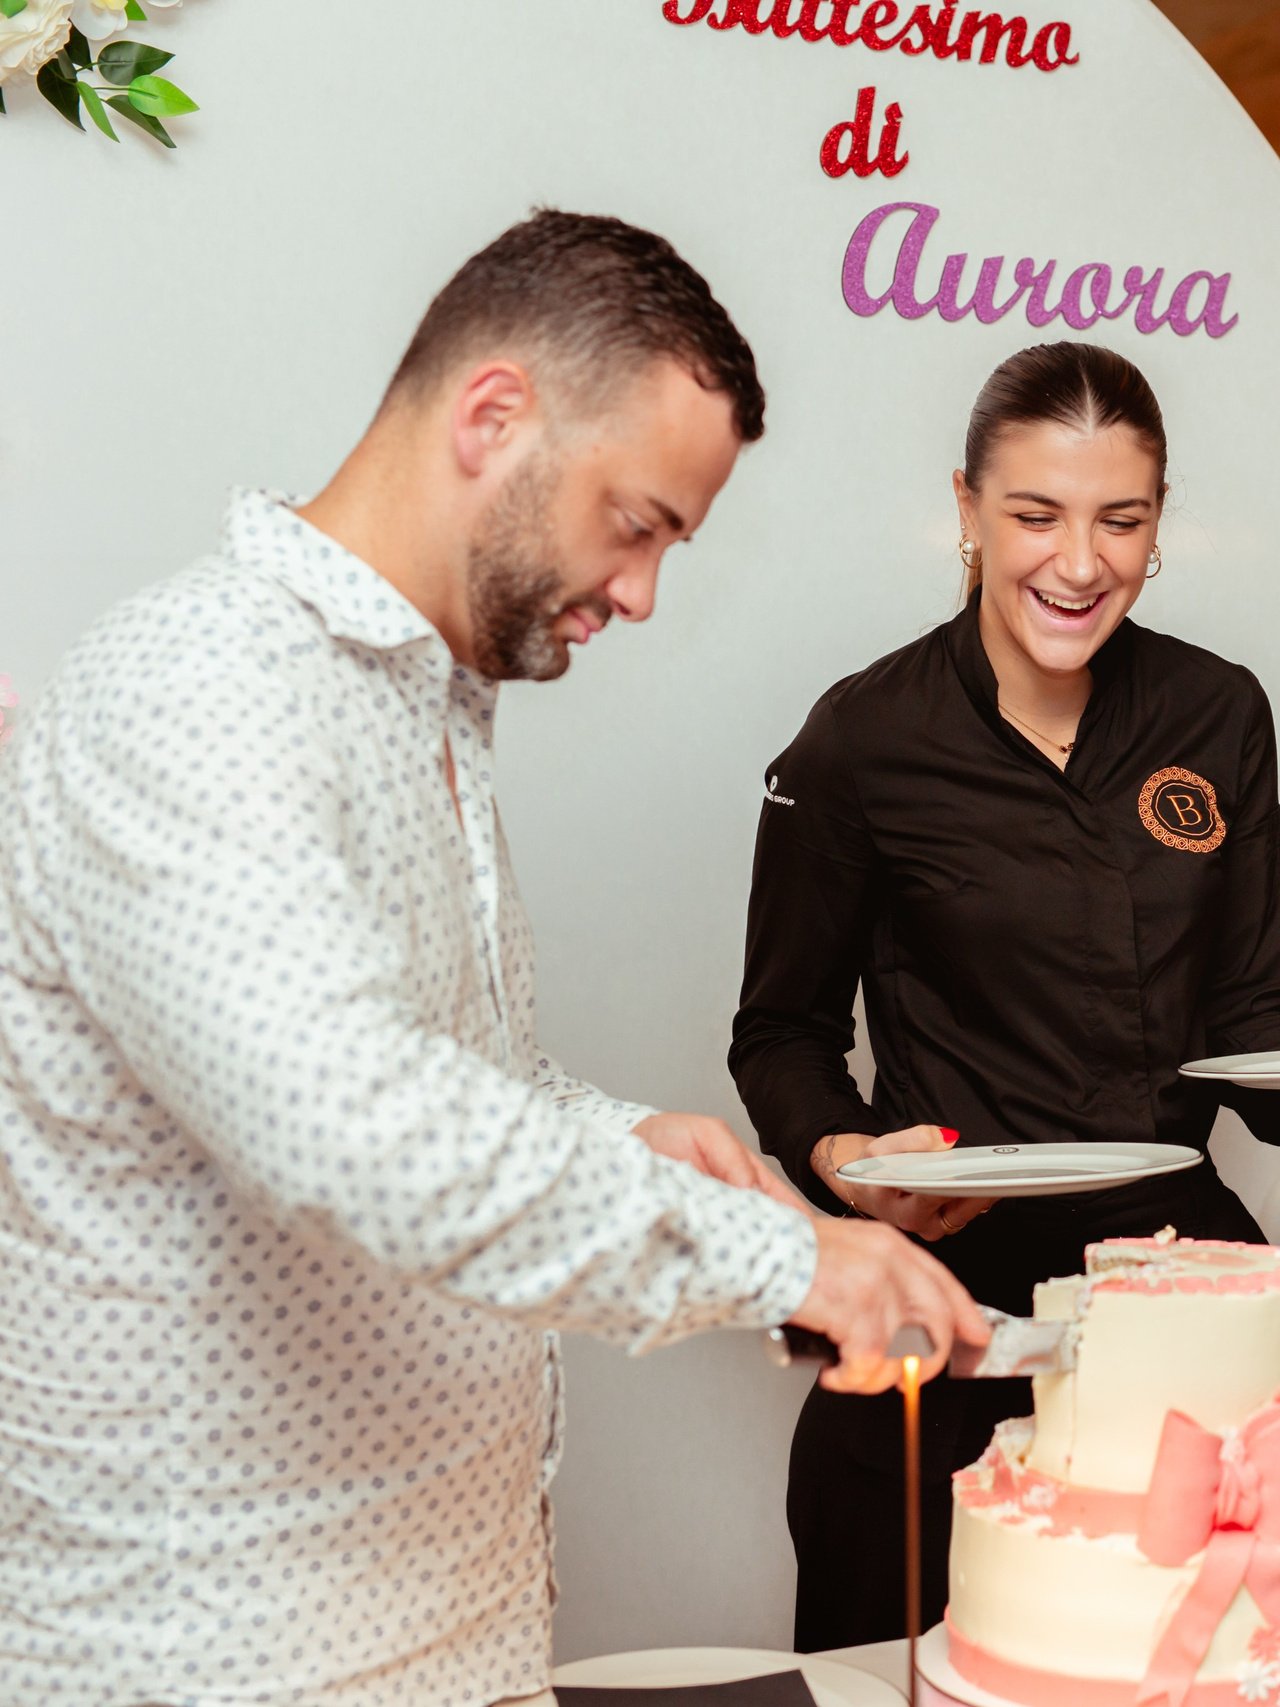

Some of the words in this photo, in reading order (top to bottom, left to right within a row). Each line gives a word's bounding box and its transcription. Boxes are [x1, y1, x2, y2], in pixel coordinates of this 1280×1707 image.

[662, 0, 1080, 71] attesimo
[820, 86, 909, 178] di
[841, 202, 1239, 338] Aurora
[774, 795, 795, 806] GROUP
[1166, 794, 1202, 826] B
